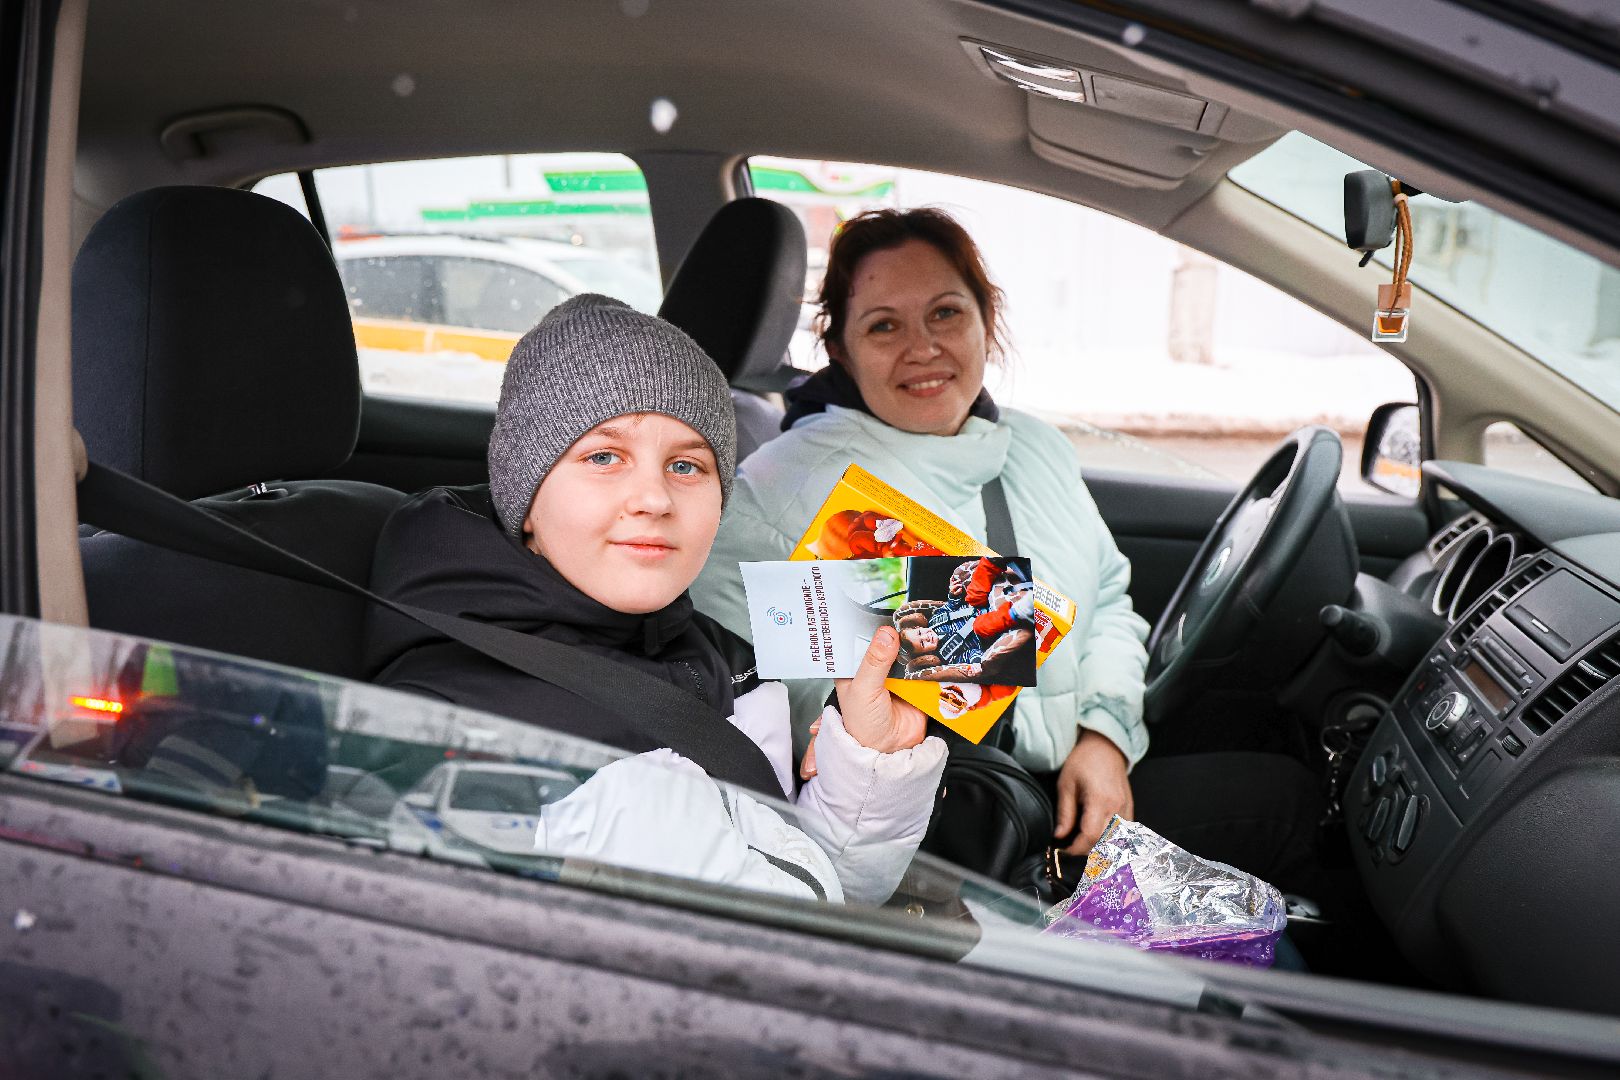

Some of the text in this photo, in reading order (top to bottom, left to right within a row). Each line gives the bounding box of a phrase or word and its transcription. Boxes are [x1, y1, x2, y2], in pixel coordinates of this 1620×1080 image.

[801, 585, 816, 627] АВТОМОБИЛЕ
[811, 566, 836, 672] ЭТО ОТВЕТСТВЕННОСТЬ ВЗРОСЛОГО
[810, 632, 821, 662] РЕБЁНОК
